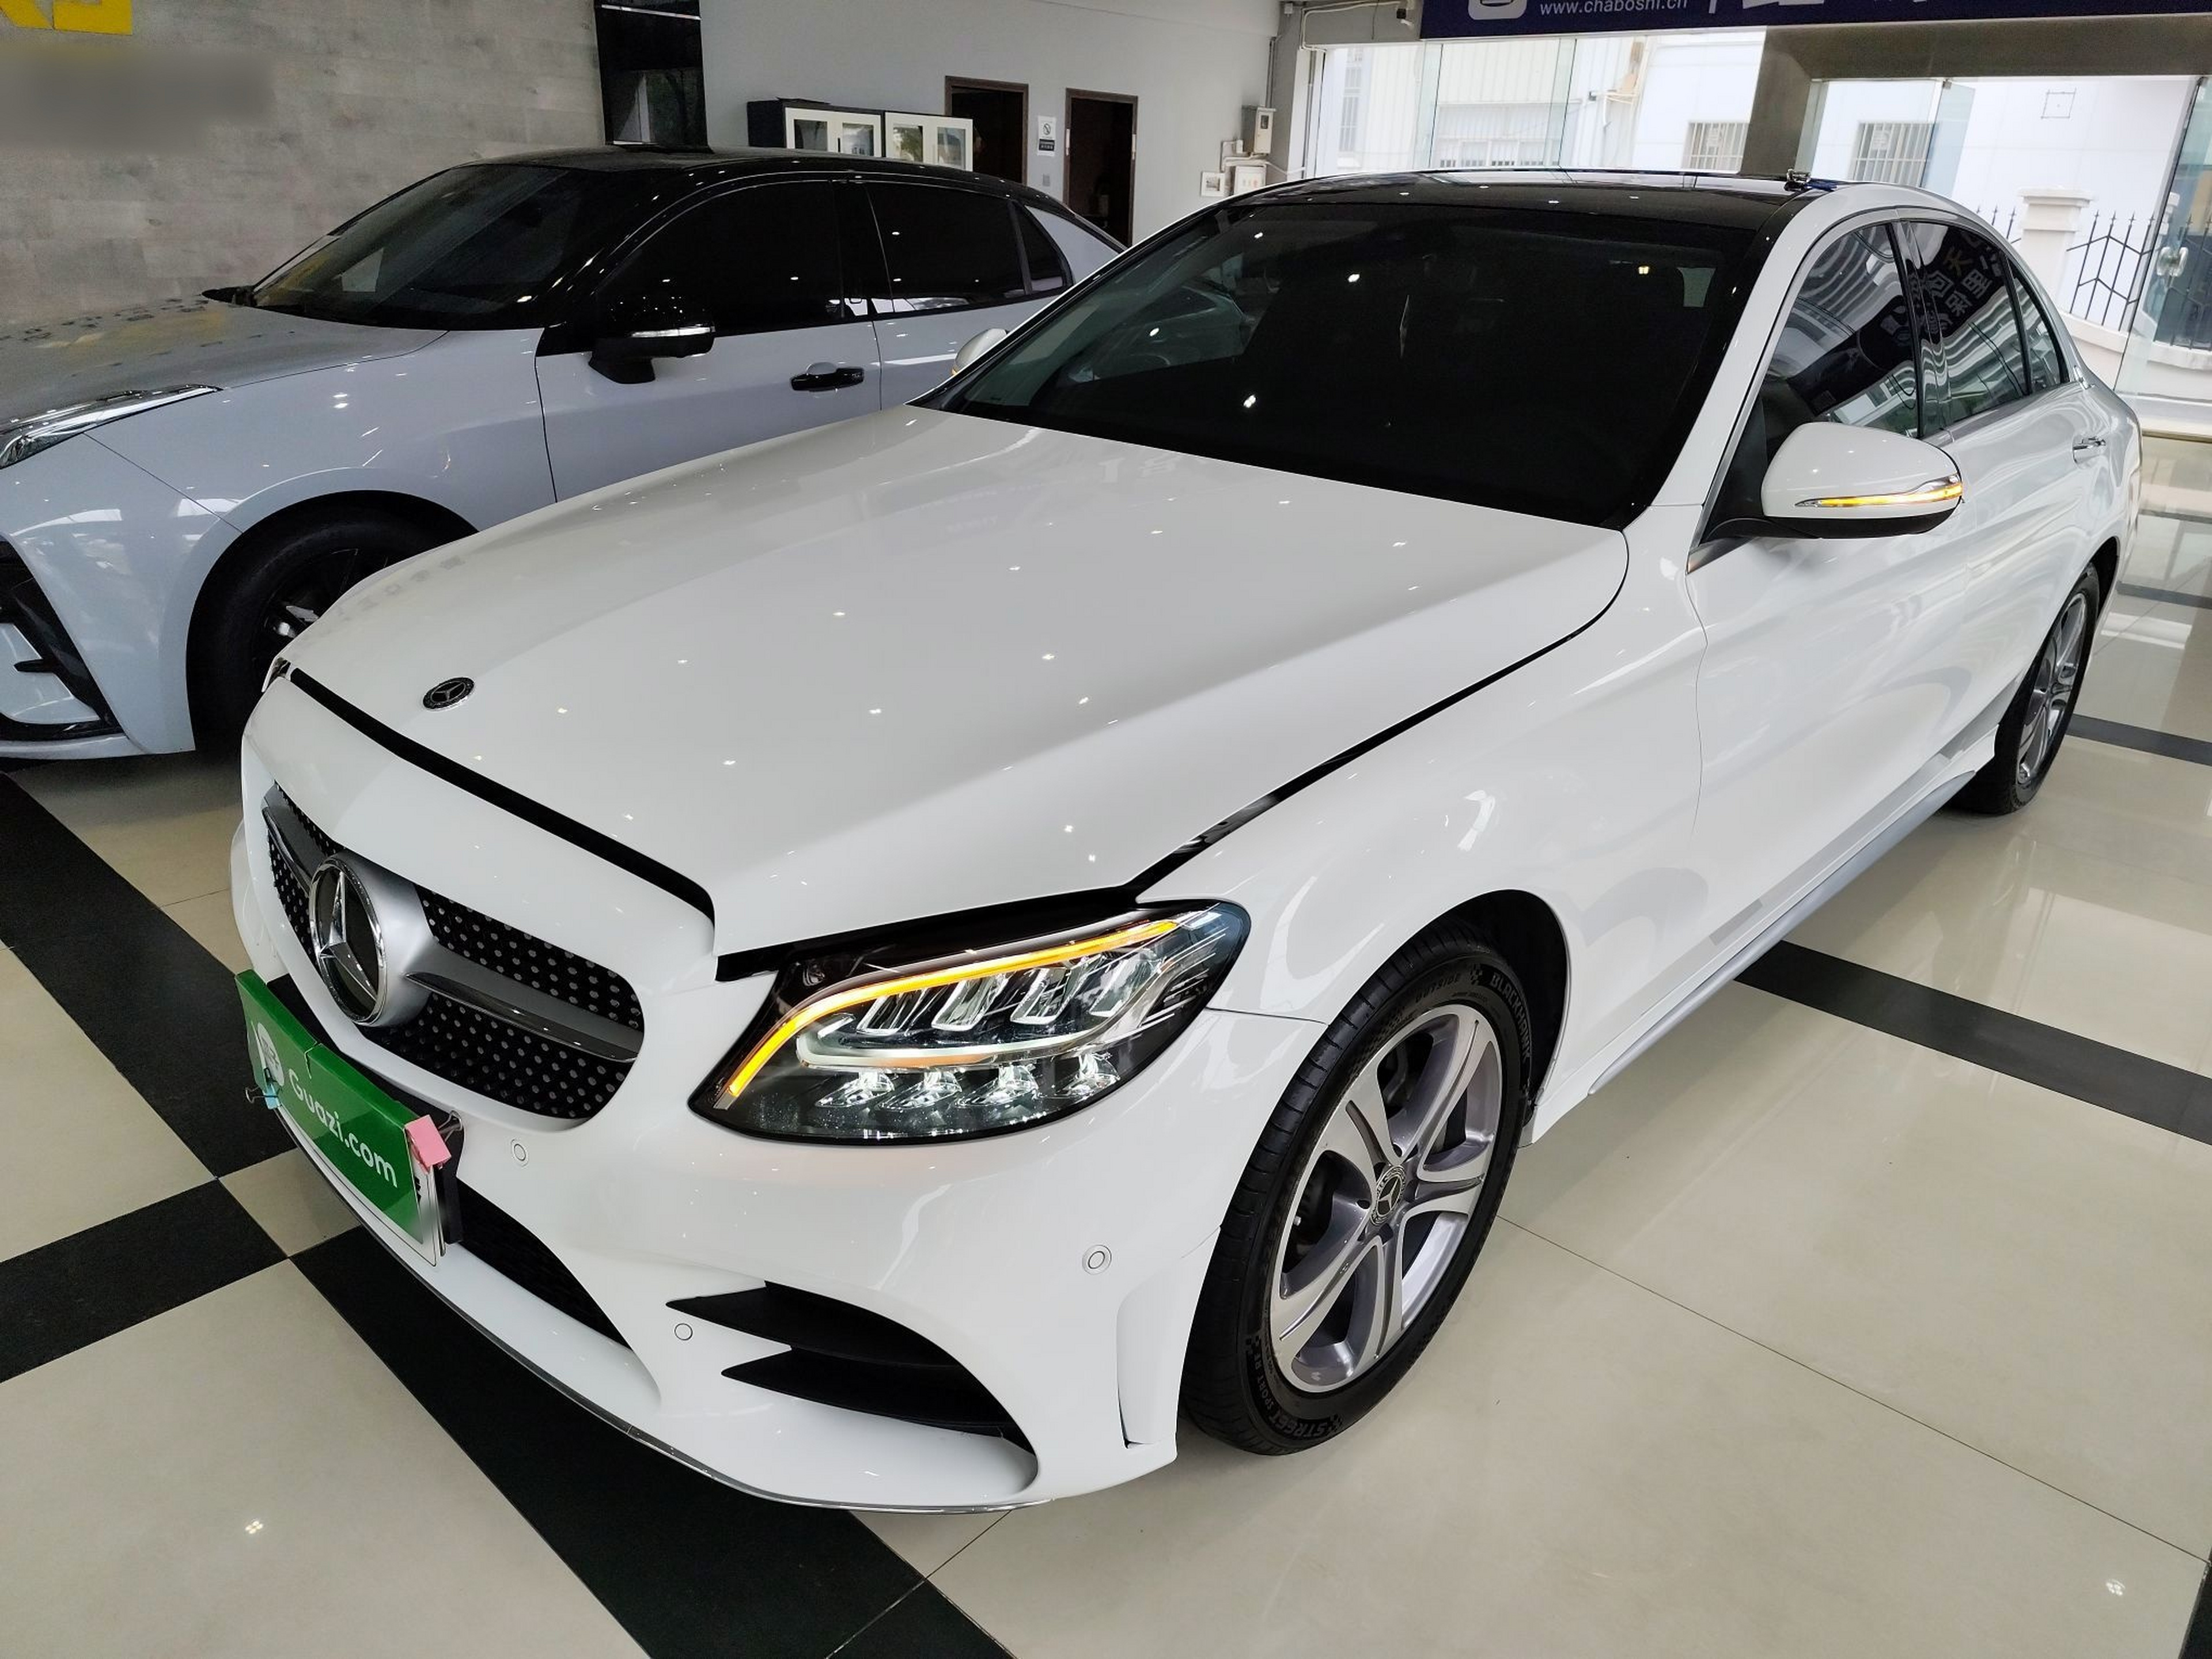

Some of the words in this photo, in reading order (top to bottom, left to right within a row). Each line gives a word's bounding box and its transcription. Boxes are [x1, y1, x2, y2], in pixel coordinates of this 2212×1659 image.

[1490, 972, 1533, 1063] BLACKHAWK
[289, 1068, 398, 1188] Guazi.com
[1257, 1376, 1274, 1410] SPORT
[1268, 1410, 1328, 1437] STREET
